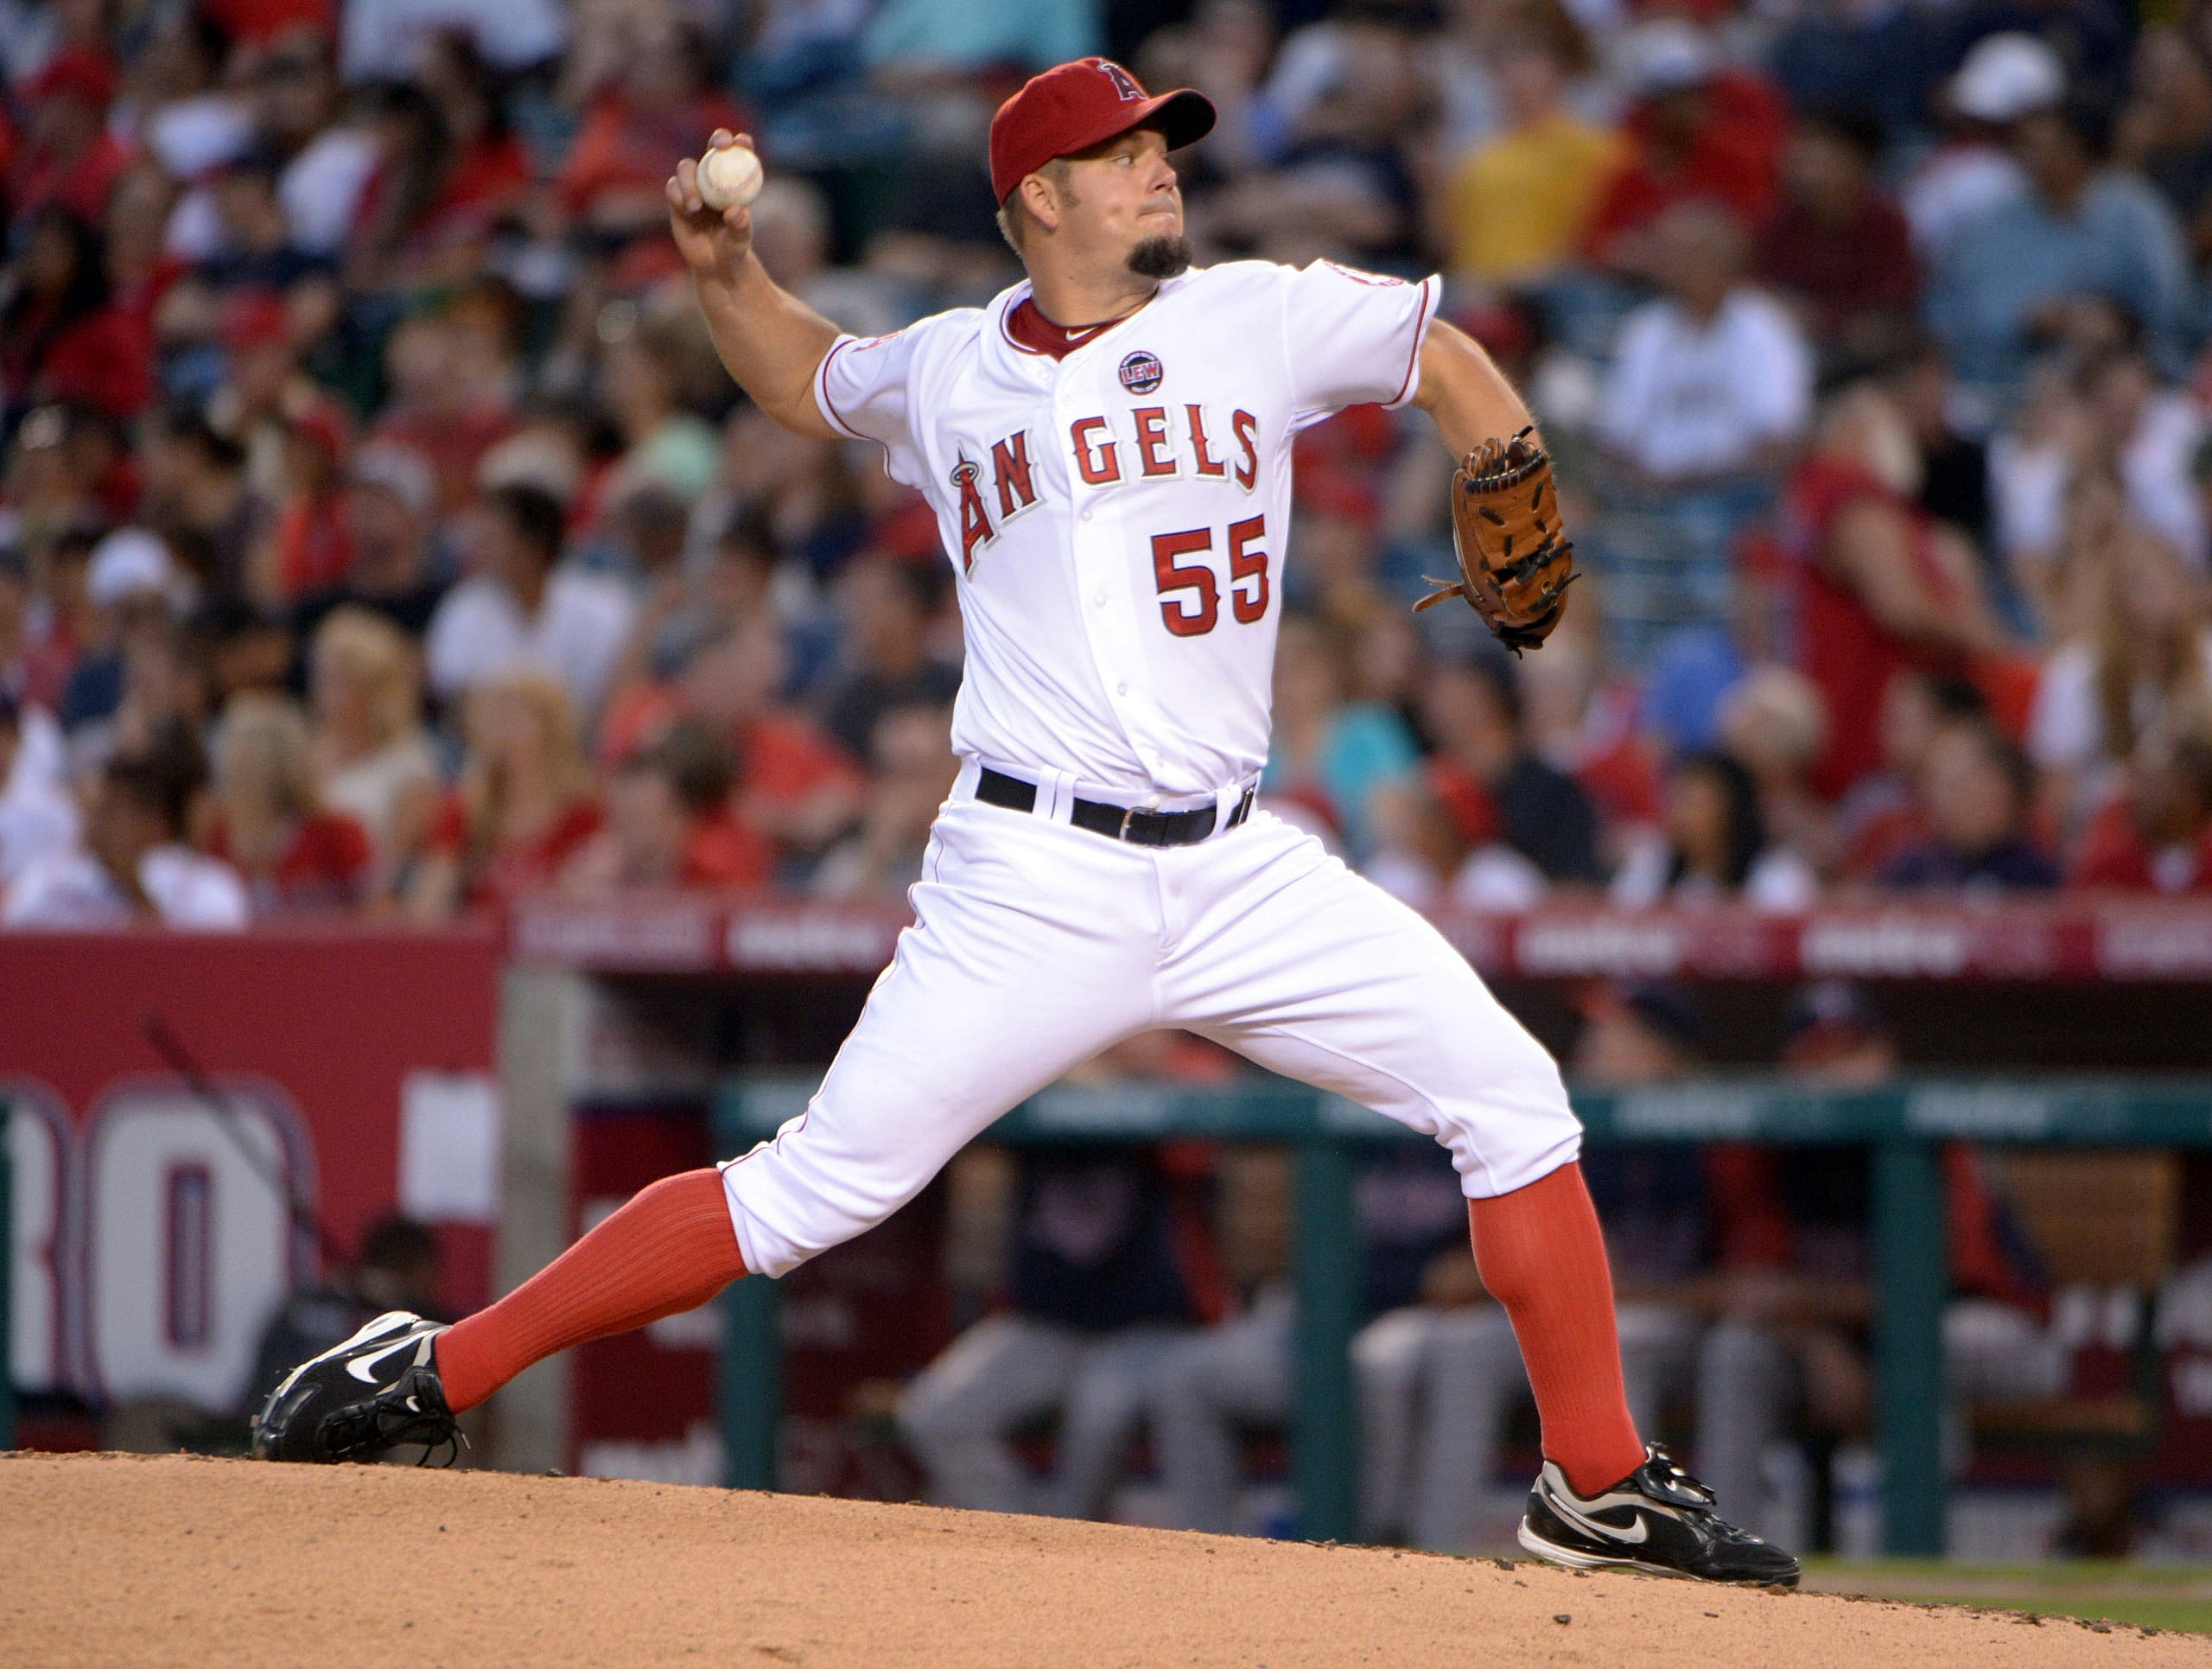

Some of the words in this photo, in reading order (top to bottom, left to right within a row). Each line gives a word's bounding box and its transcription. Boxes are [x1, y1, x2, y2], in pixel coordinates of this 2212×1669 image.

[1097, 60, 1149, 101] A
[1121, 361, 1160, 385] LEW
[950, 404, 1262, 583] ANGELS
[1150, 513, 1271, 638] 55
